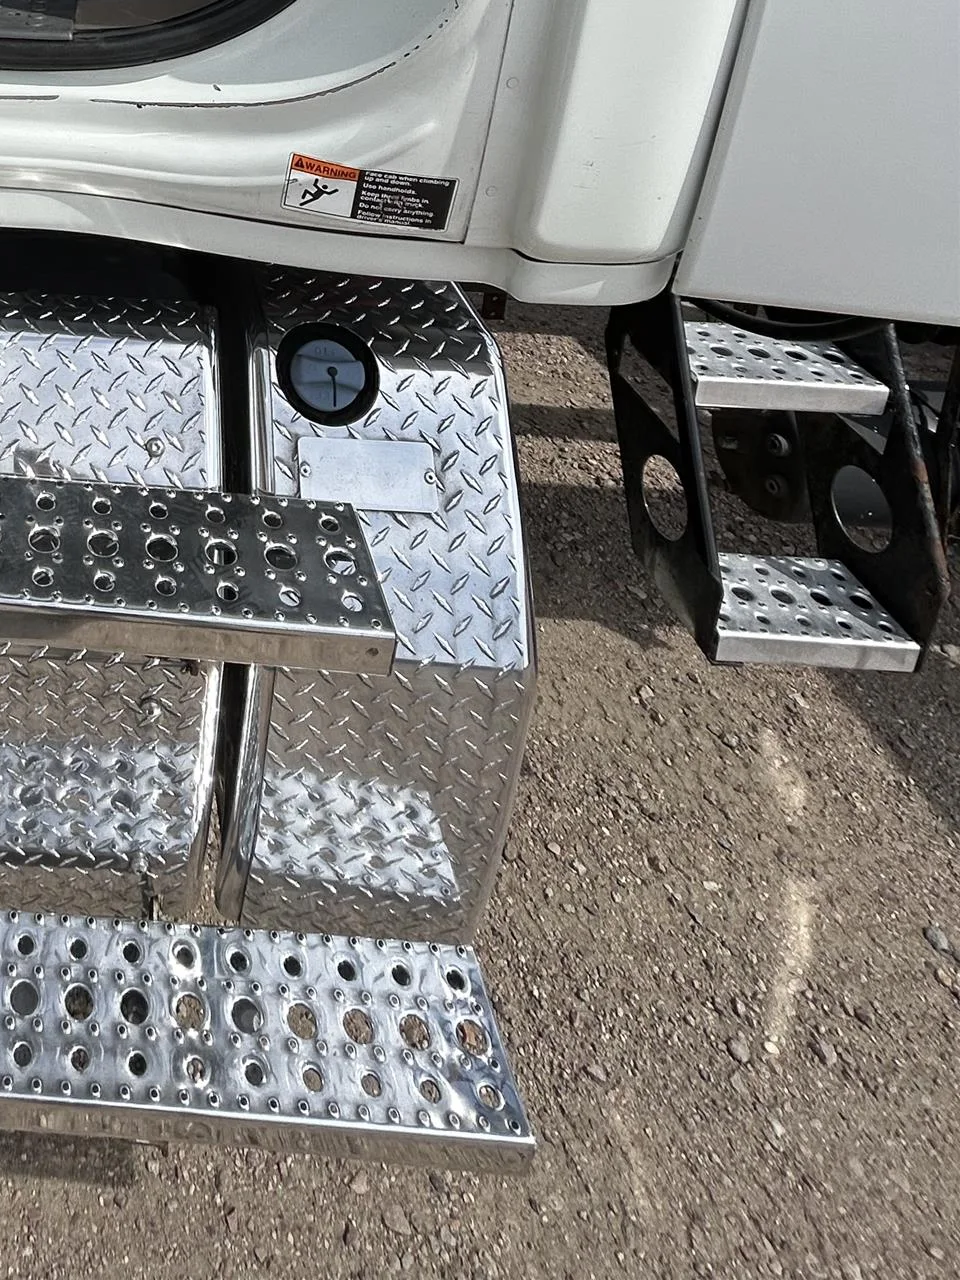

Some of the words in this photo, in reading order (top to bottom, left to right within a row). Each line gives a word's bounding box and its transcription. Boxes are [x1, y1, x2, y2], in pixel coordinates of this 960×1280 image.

[305, 161, 357, 179] WARNING
[363, 182, 377, 190] Use
[419, 178, 450, 187] climbing
[361, 190, 380, 198] Keep
